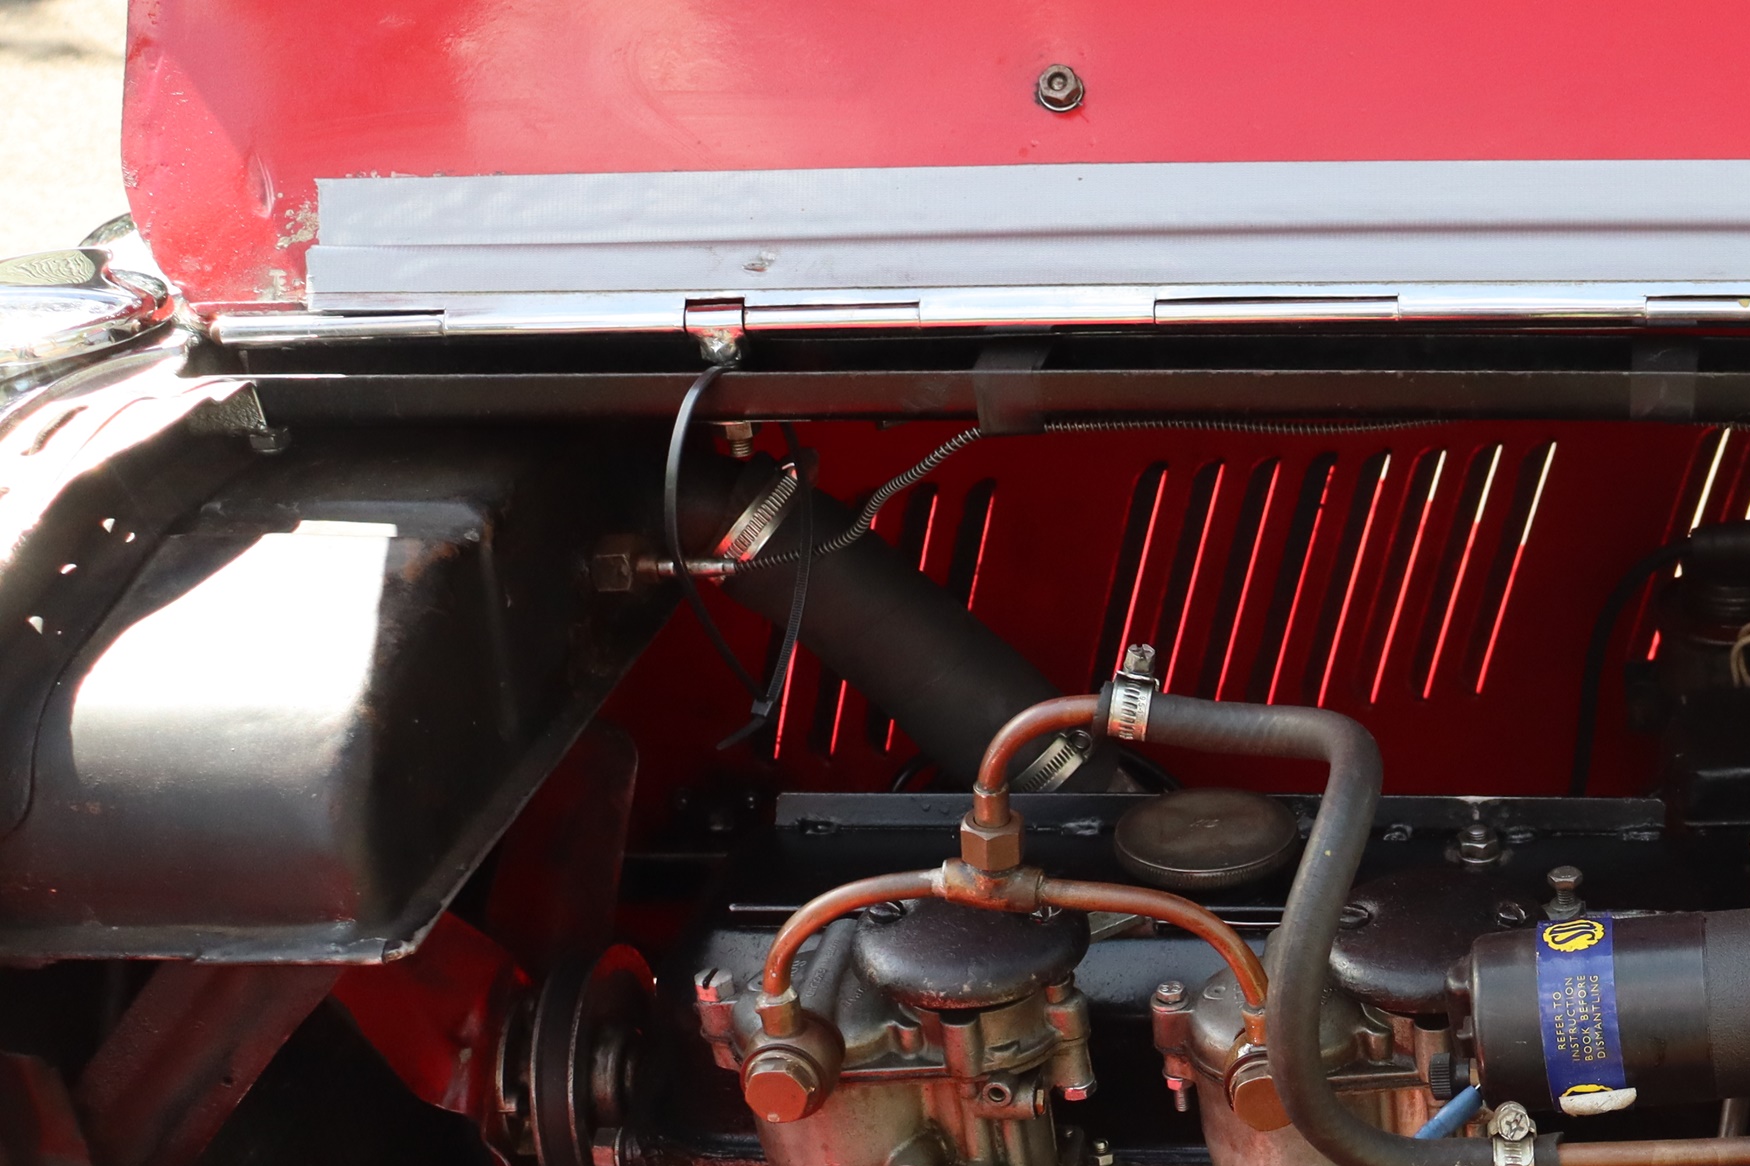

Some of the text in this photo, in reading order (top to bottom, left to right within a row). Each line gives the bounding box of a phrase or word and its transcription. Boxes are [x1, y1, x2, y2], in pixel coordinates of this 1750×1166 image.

[1552, 991, 1566, 1050] REFER TO
[1565, 977, 1580, 1062] INSTRUCTION
[1577, 975, 1593, 1061] BOOK BEFORE
[1590, 975, 1606, 1059] DISMANTLING
